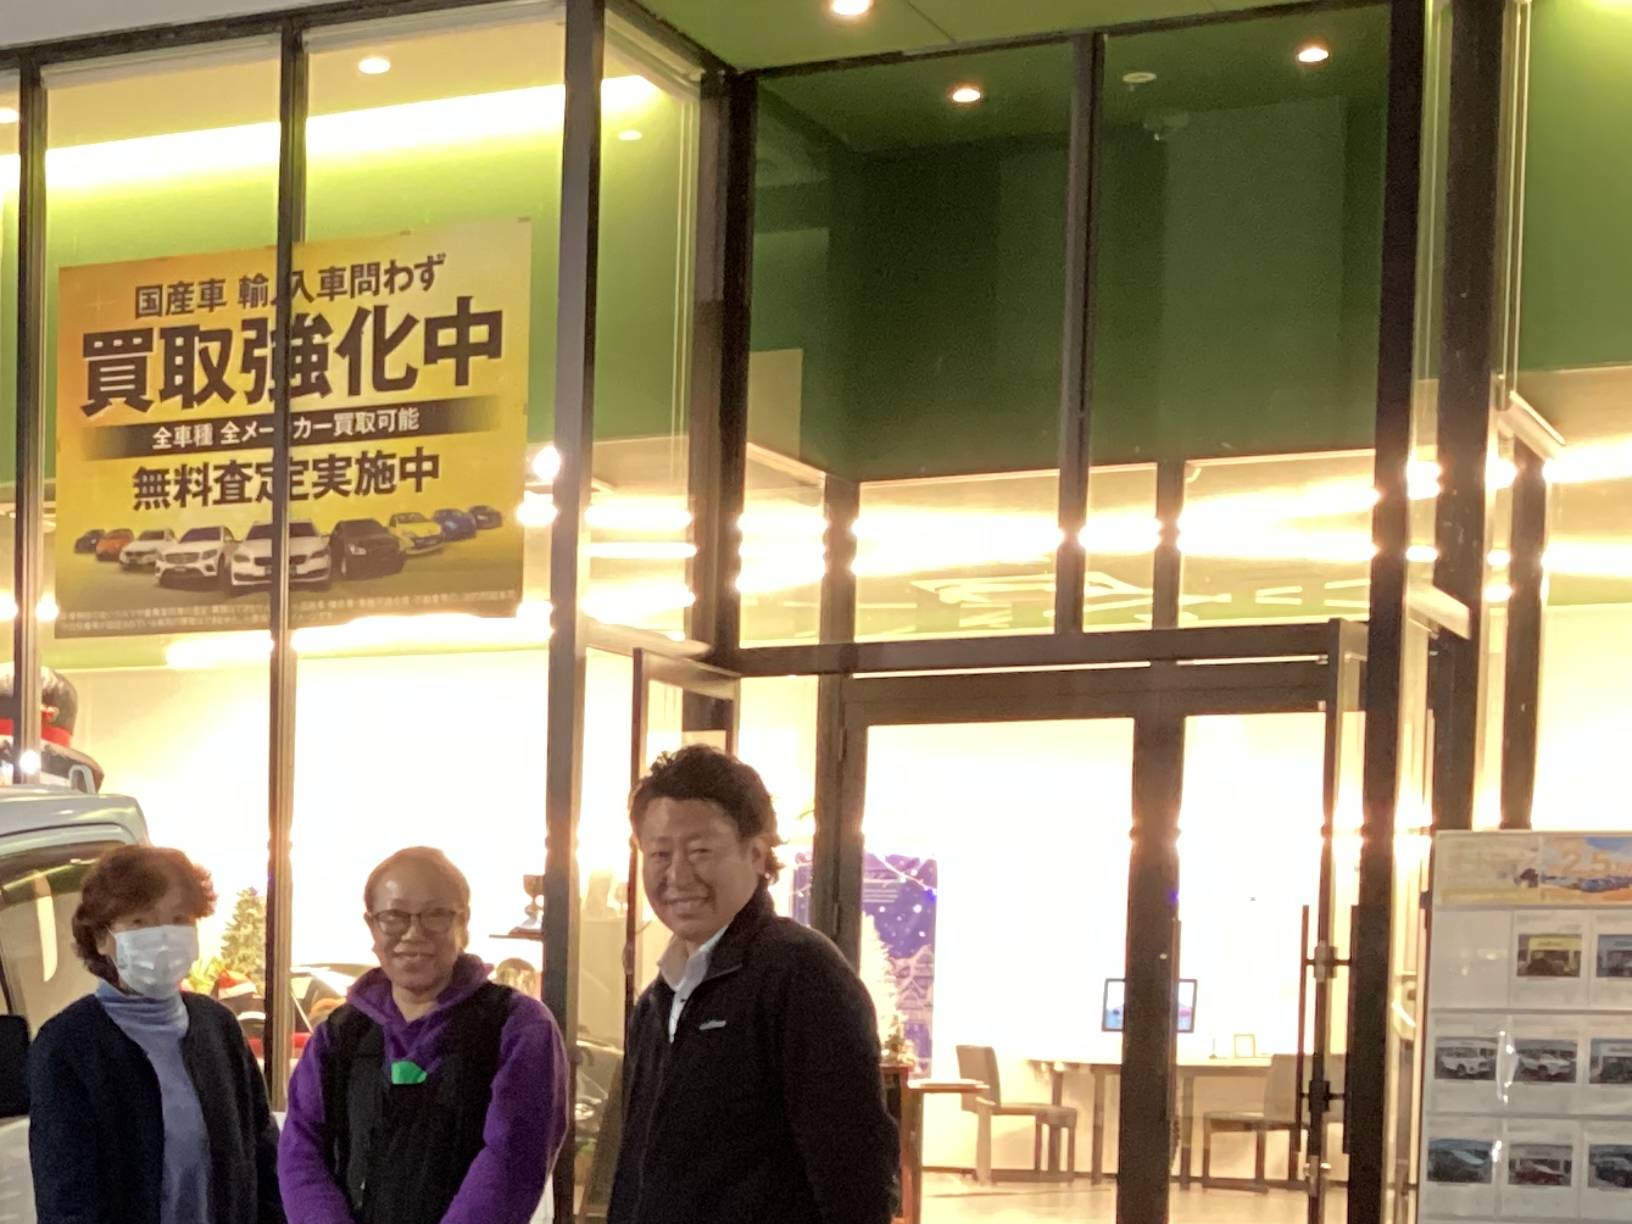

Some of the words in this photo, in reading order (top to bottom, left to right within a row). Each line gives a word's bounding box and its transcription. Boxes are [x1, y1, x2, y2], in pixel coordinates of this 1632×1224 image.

[134, 278, 227, 320] 国産車
[238, 252, 447, 309] 輸入車問わず
[80, 296, 503, 418] 買取強化中
[151, 423, 214, 450] 全車種
[132, 446, 441, 511] 無料査定実施中
